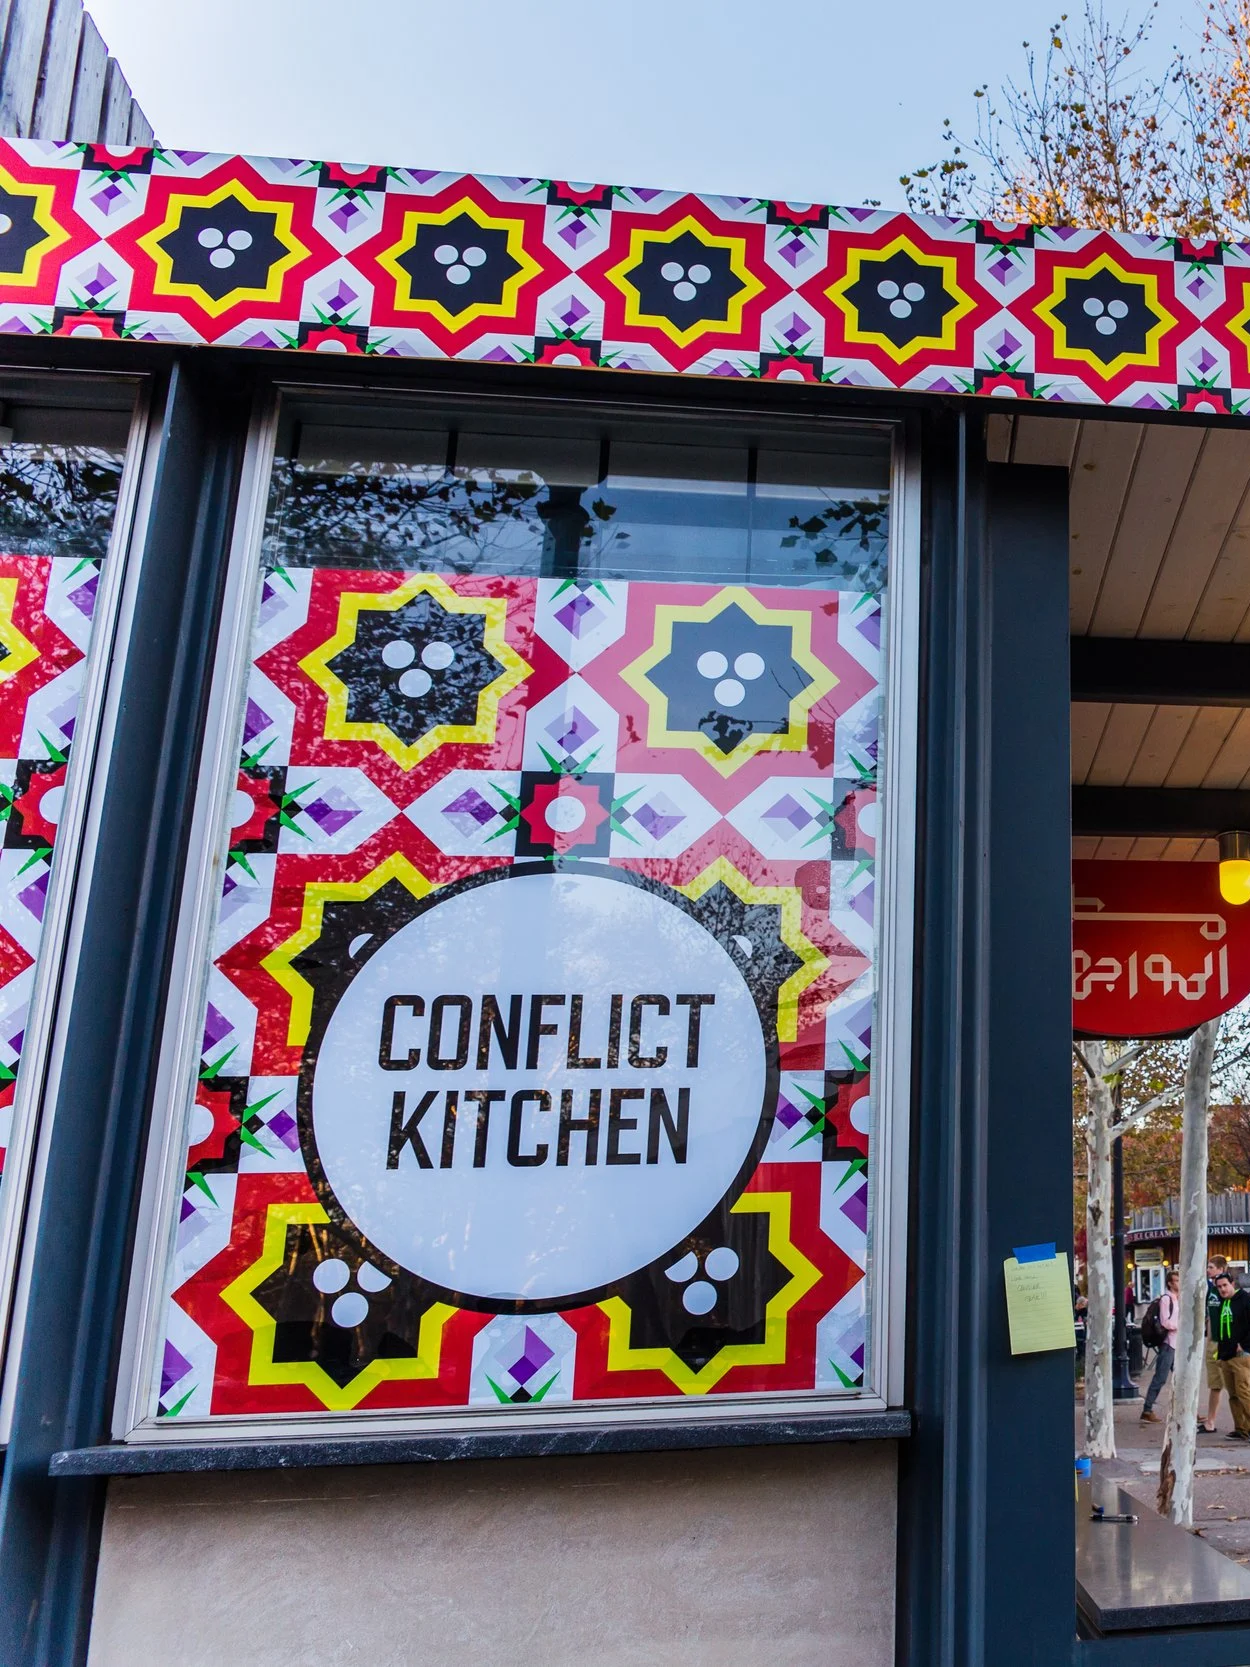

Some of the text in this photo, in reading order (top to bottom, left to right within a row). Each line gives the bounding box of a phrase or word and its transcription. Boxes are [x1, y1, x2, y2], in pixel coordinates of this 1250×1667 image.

[378, 994, 715, 1071] CONFLICT
[386, 1087, 690, 1170] KITCHEN
[1208, 1226, 1245, 1235] DRINKS
